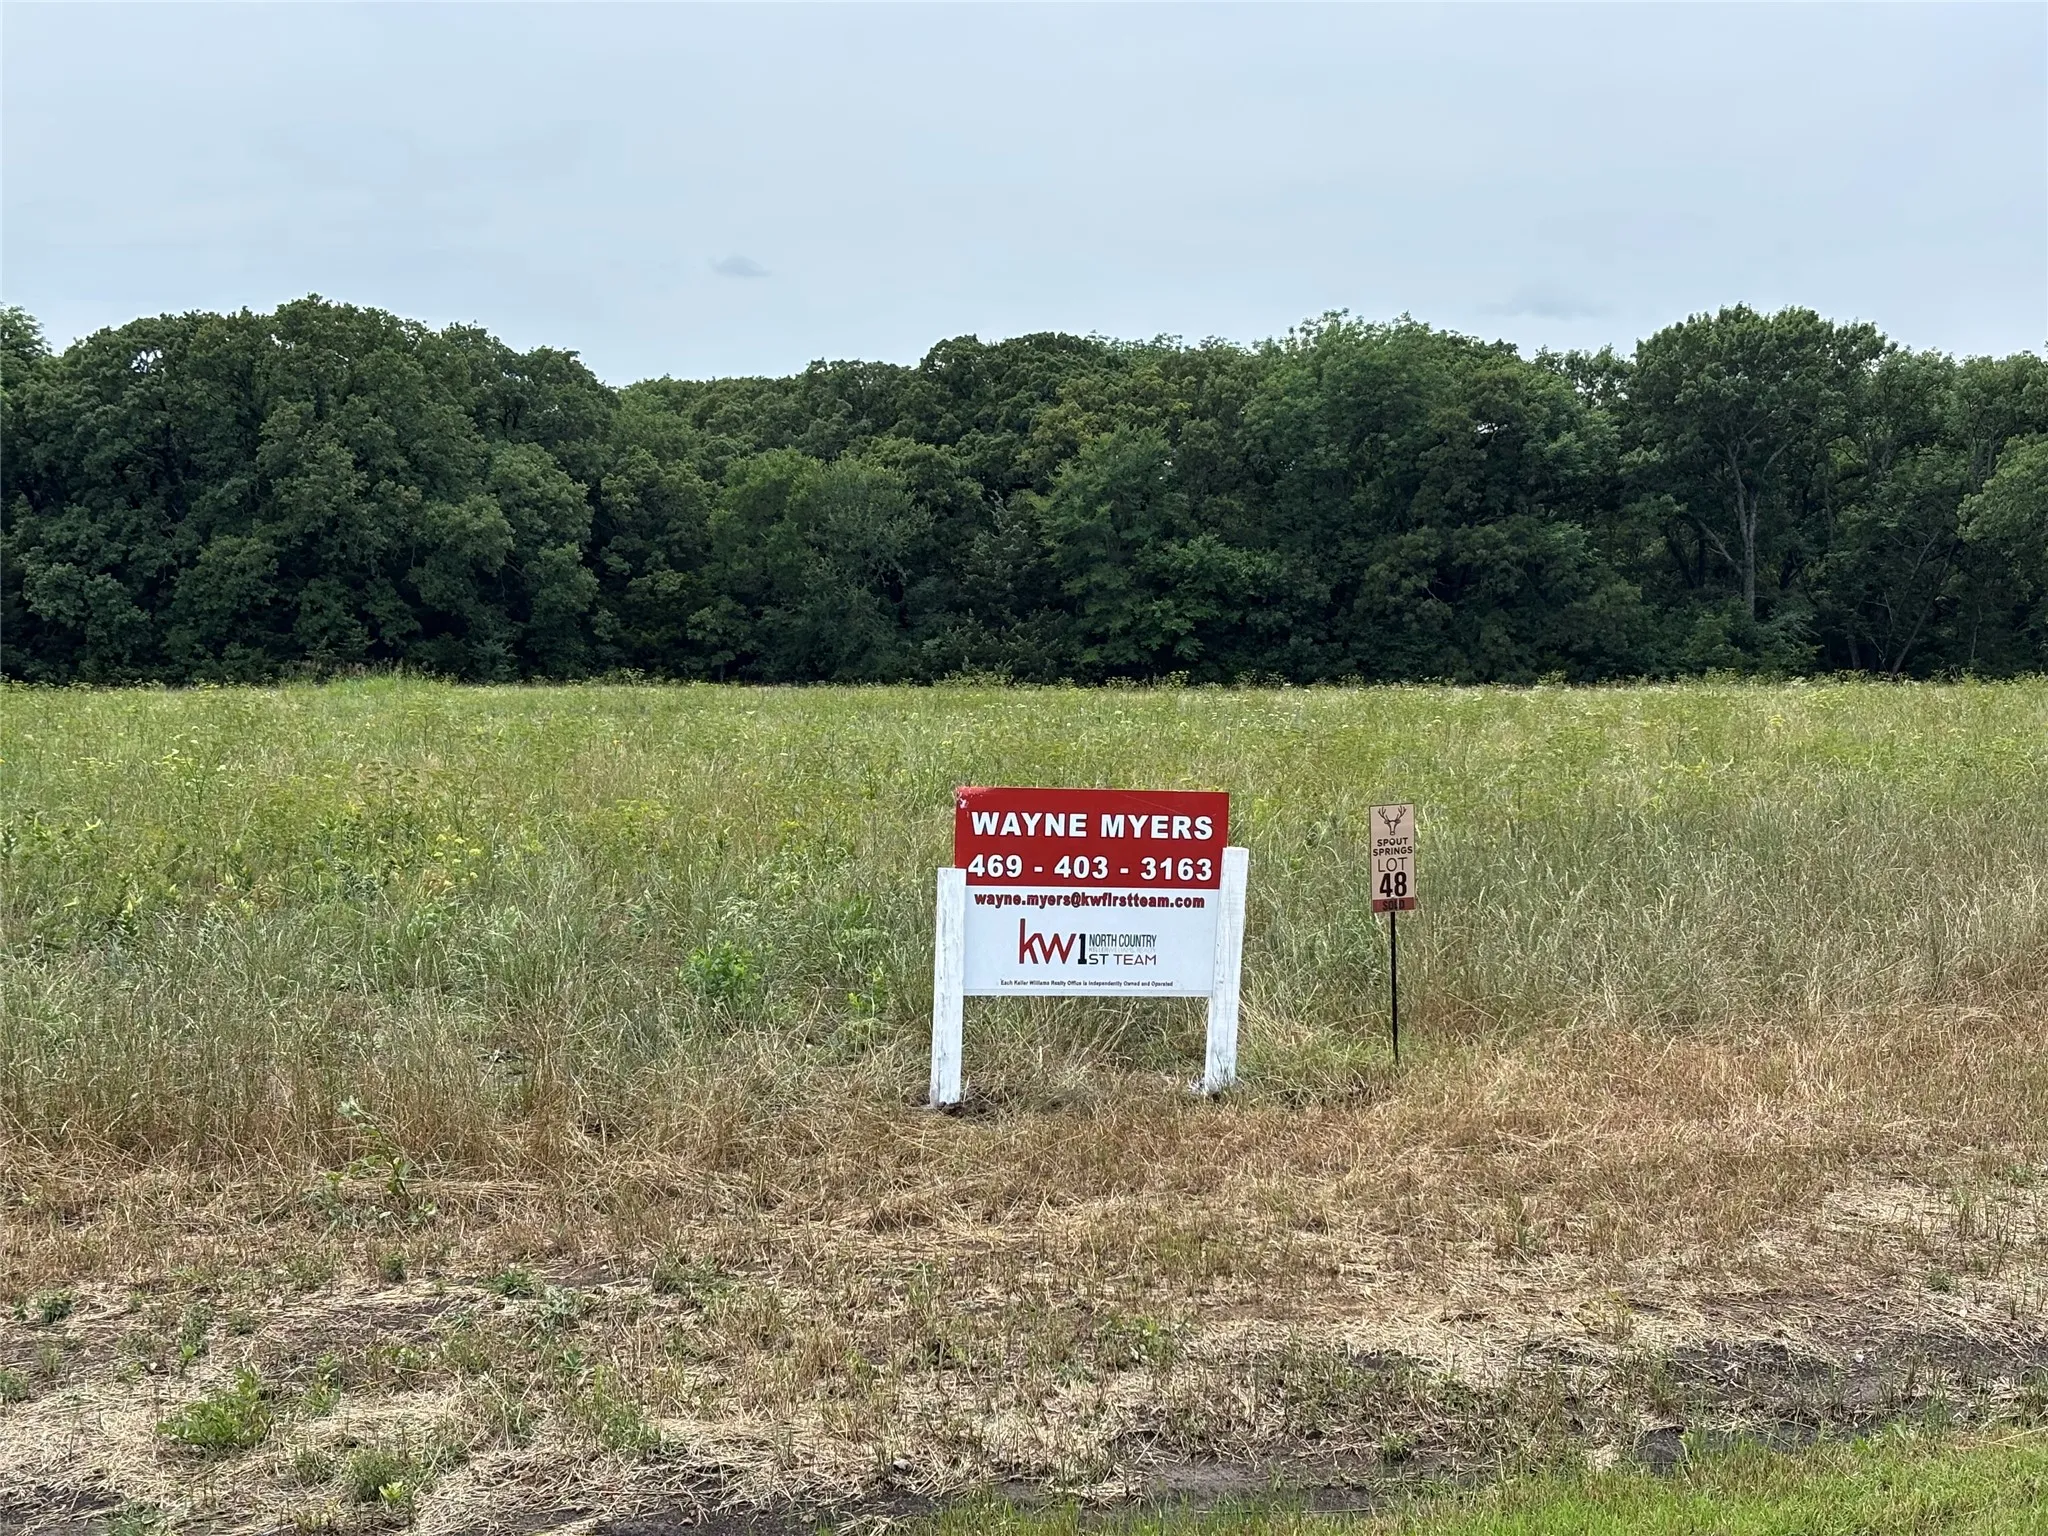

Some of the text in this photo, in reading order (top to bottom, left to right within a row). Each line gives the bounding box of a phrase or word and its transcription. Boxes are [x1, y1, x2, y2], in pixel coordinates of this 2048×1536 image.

[971, 811, 1214, 840] WAYNE MYERS
[1377, 837, 1408, 847] SPOUT
[1373, 846, 1413, 856] SPRINGS
[967, 853, 1023, 878] 469
[1053, 855, 1109, 879] 403
[1140, 857, 1213, 880] 3163
[1378, 857, 1407, 872] LOT
[1379, 871, 1407, 897] 48
[974, 892, 1205, 909] wayne.myers@kwfirstteam.com
[1382, 900, 1405, 911] SOLD
[1089, 933, 1157, 948] NORTH COUNTRY
[1113, 953, 1156, 965] TEAM
